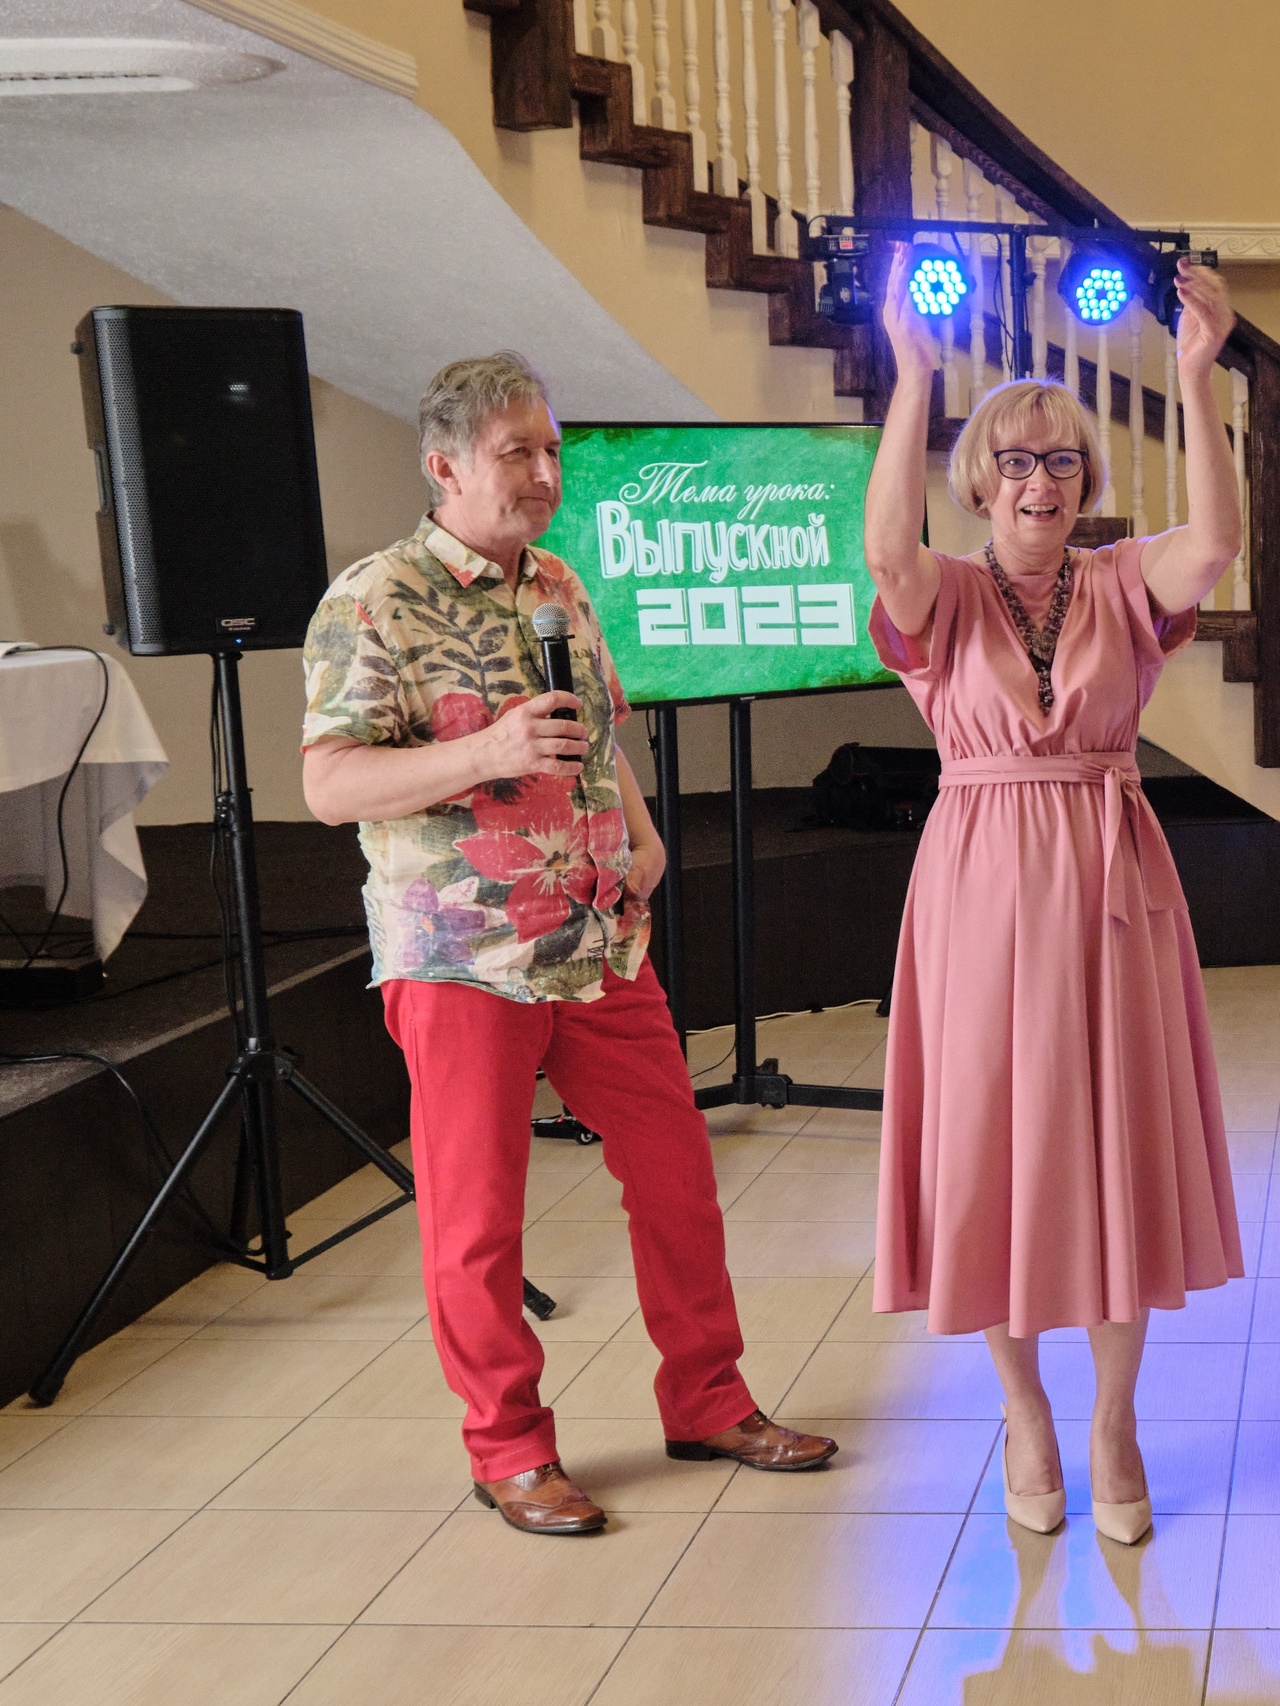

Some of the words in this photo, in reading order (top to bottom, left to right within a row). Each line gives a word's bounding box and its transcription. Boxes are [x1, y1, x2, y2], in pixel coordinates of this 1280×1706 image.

[620, 461, 736, 505] Тема
[738, 482, 834, 519] урока:
[597, 501, 829, 583] Выпускной
[637, 584, 857, 646] 2023
